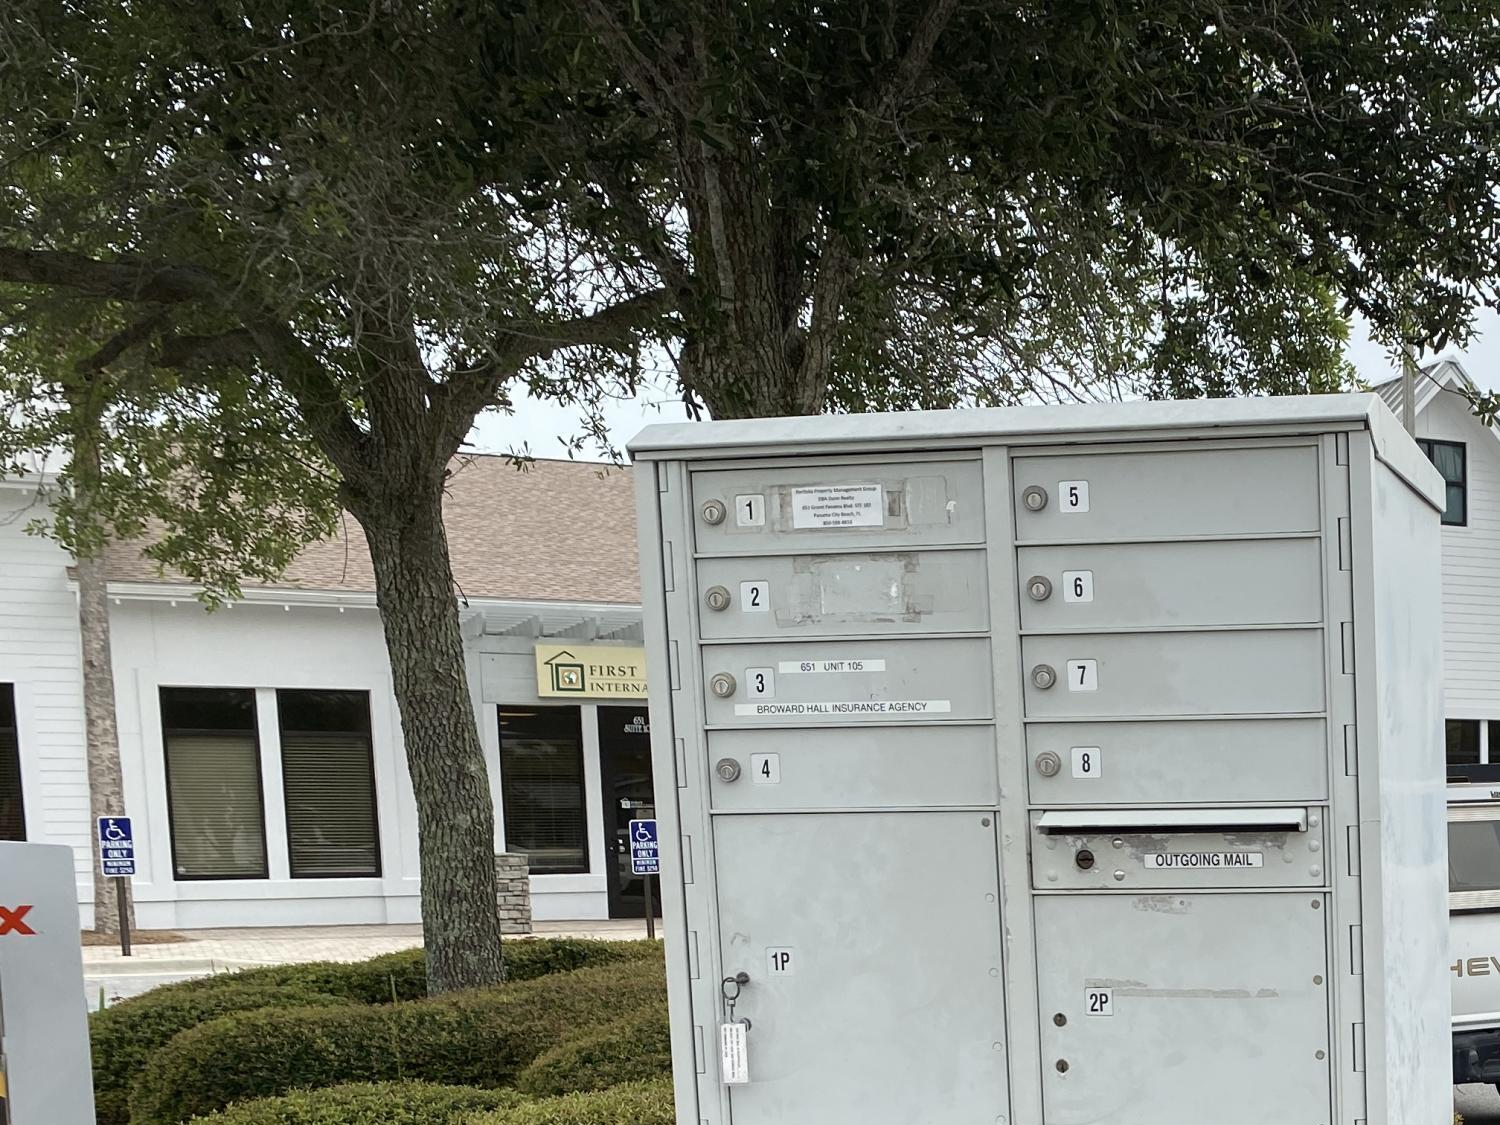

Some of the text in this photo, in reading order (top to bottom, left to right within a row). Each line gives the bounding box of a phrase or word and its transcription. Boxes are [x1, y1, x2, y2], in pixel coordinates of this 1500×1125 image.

[1069, 486, 1079, 507] 5
[745, 500, 753, 520] 1
[1073, 577, 1084, 598] 6
[749, 586, 760, 607] 2
[589, 665, 638, 677] FIRST
[800, 662, 863, 671] 651 UNIT 105
[755, 673, 765, 693] 3
[1077, 665, 1087, 686] 7
[590, 682, 648, 692] INTERNA
[757, 703, 927, 713] BROWARD HALL INSURANCE AGENCY
[624, 724, 642, 733] SUITE
[633, 716, 644, 725] 651
[761, 759, 771, 778] 4
[1081, 753, 1091, 773] 8
[108, 849, 128, 858] ONLY
[633, 841, 658, 850] PARKING
[637, 849, 653, 858] ONLY
[1155, 853, 1253, 867] OUTGOING MAIL
[770, 952, 791, 971] 1P
[1089, 993, 1109, 1012] 2P
